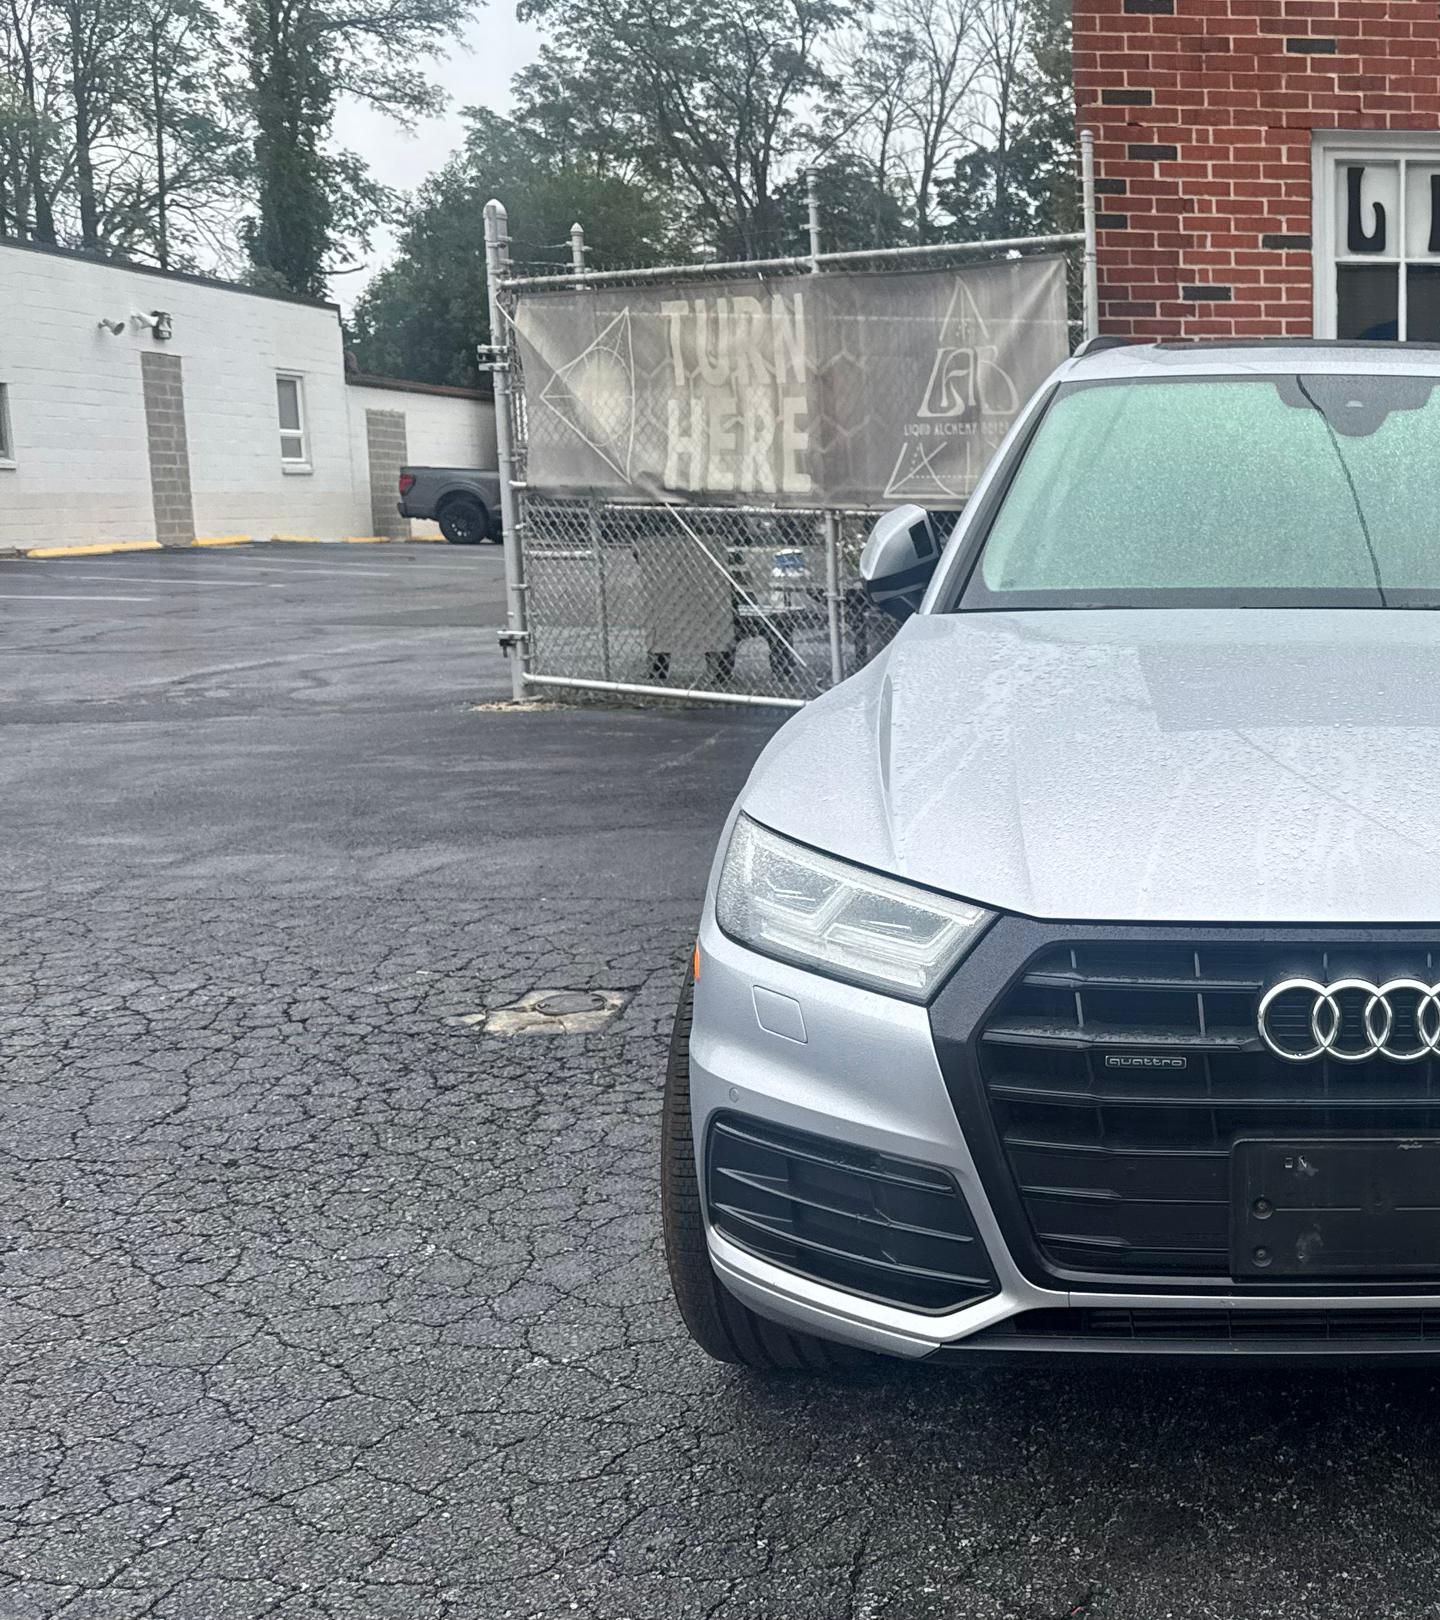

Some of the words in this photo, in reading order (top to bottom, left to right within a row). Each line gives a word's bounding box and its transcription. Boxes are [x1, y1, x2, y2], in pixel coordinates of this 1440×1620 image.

[660, 293, 807, 385] TURN
[664, 397, 812, 493] HERE
[904, 423, 931, 436] LIQUID
[934, 422, 978, 436] ALCHEMY
[1109, 1058, 1183, 1066] quattro
